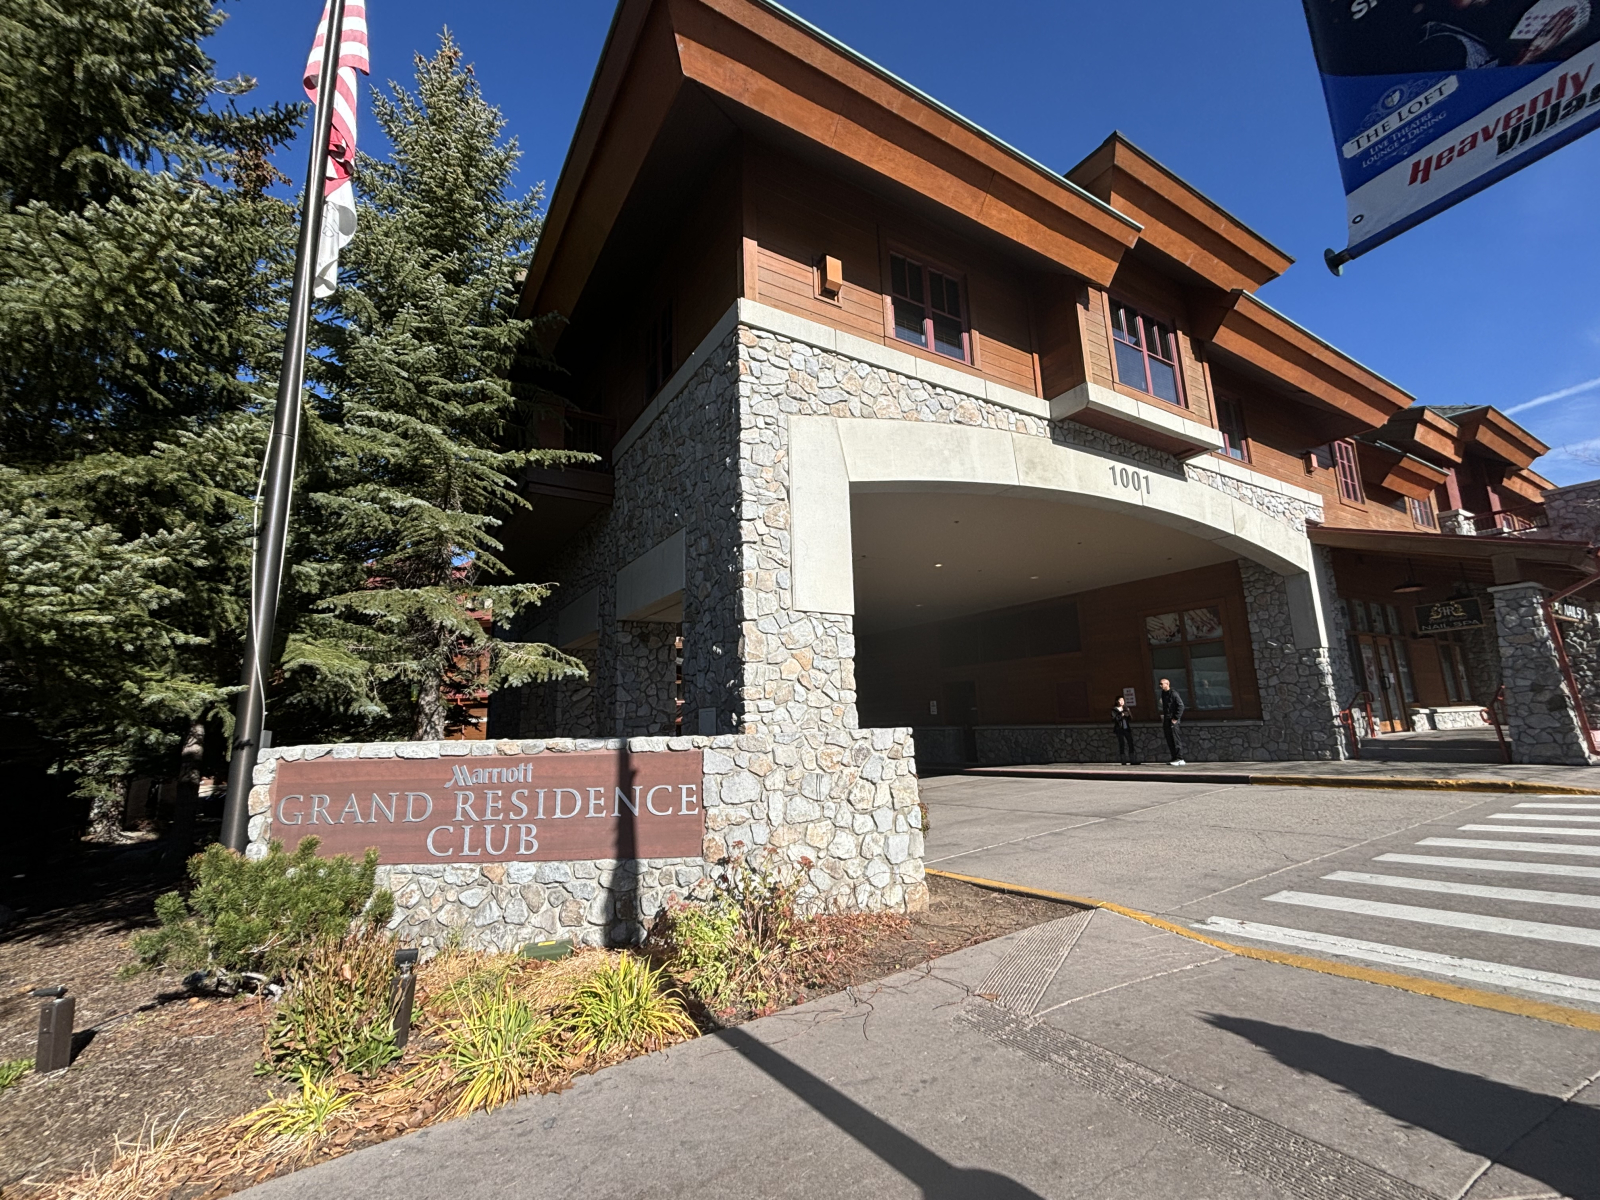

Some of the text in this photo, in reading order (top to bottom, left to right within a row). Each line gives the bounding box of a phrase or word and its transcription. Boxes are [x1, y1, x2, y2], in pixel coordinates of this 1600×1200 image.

[1350, 83, 1447, 150] THE LOFT
[1369, 111, 1434, 156] LIVE THEATRE
[1408, 63, 1595, 186] Heavenly
[1362, 110, 1447, 168] LOUNGE DINING
[1108, 464, 1151, 495] 1001
[1421, 623, 1449, 631] NAIL
[1453, 619, 1480, 627] SPA
[443, 762, 534, 789] Marriott
[275, 784, 699, 826] GRAND RESIDENCE
[426, 823, 540, 858] CLUB
